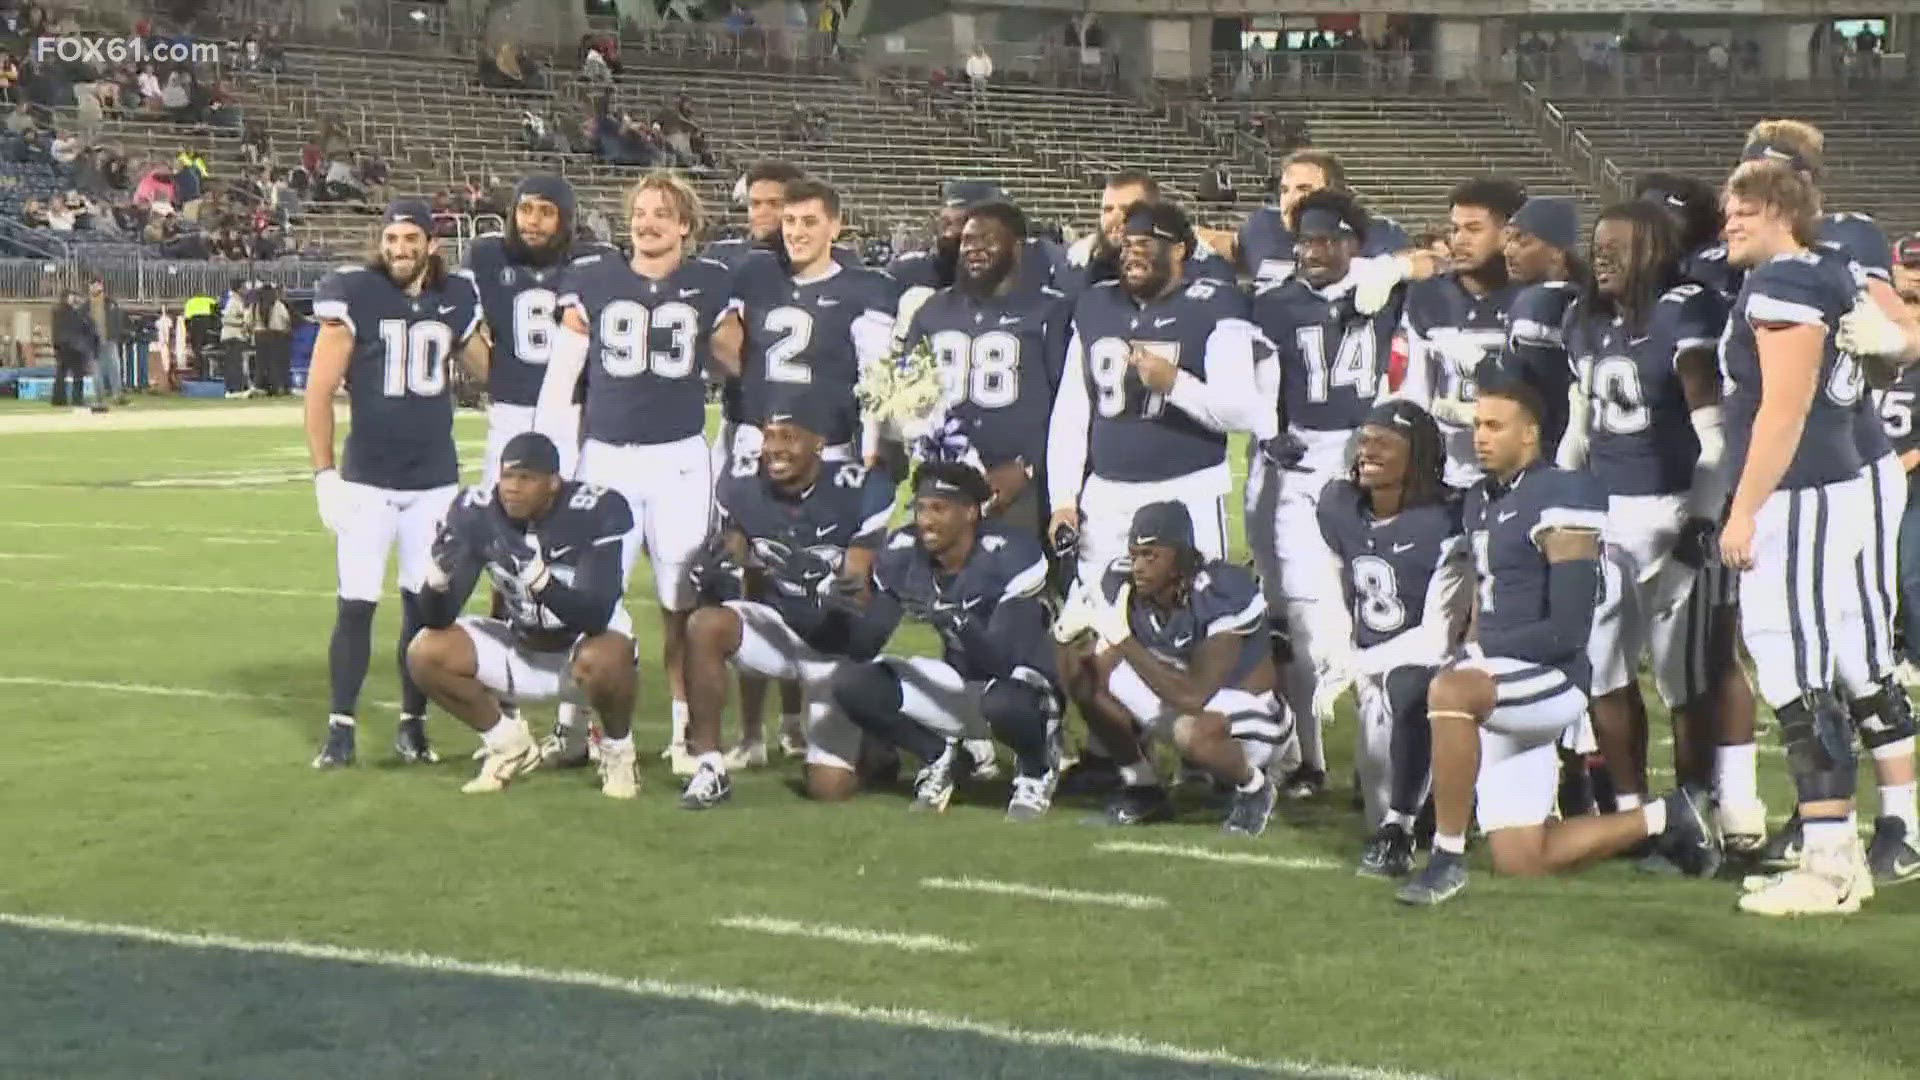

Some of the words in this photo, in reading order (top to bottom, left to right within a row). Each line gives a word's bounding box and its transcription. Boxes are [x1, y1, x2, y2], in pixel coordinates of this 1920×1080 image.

[379, 319, 452, 397] 10
[601, 299, 699, 378] 93
[764, 306, 814, 384] 2
[931, 330, 1021, 408] 98
[1296, 318, 1377, 403] 14
[1352, 555, 1406, 632] 8
